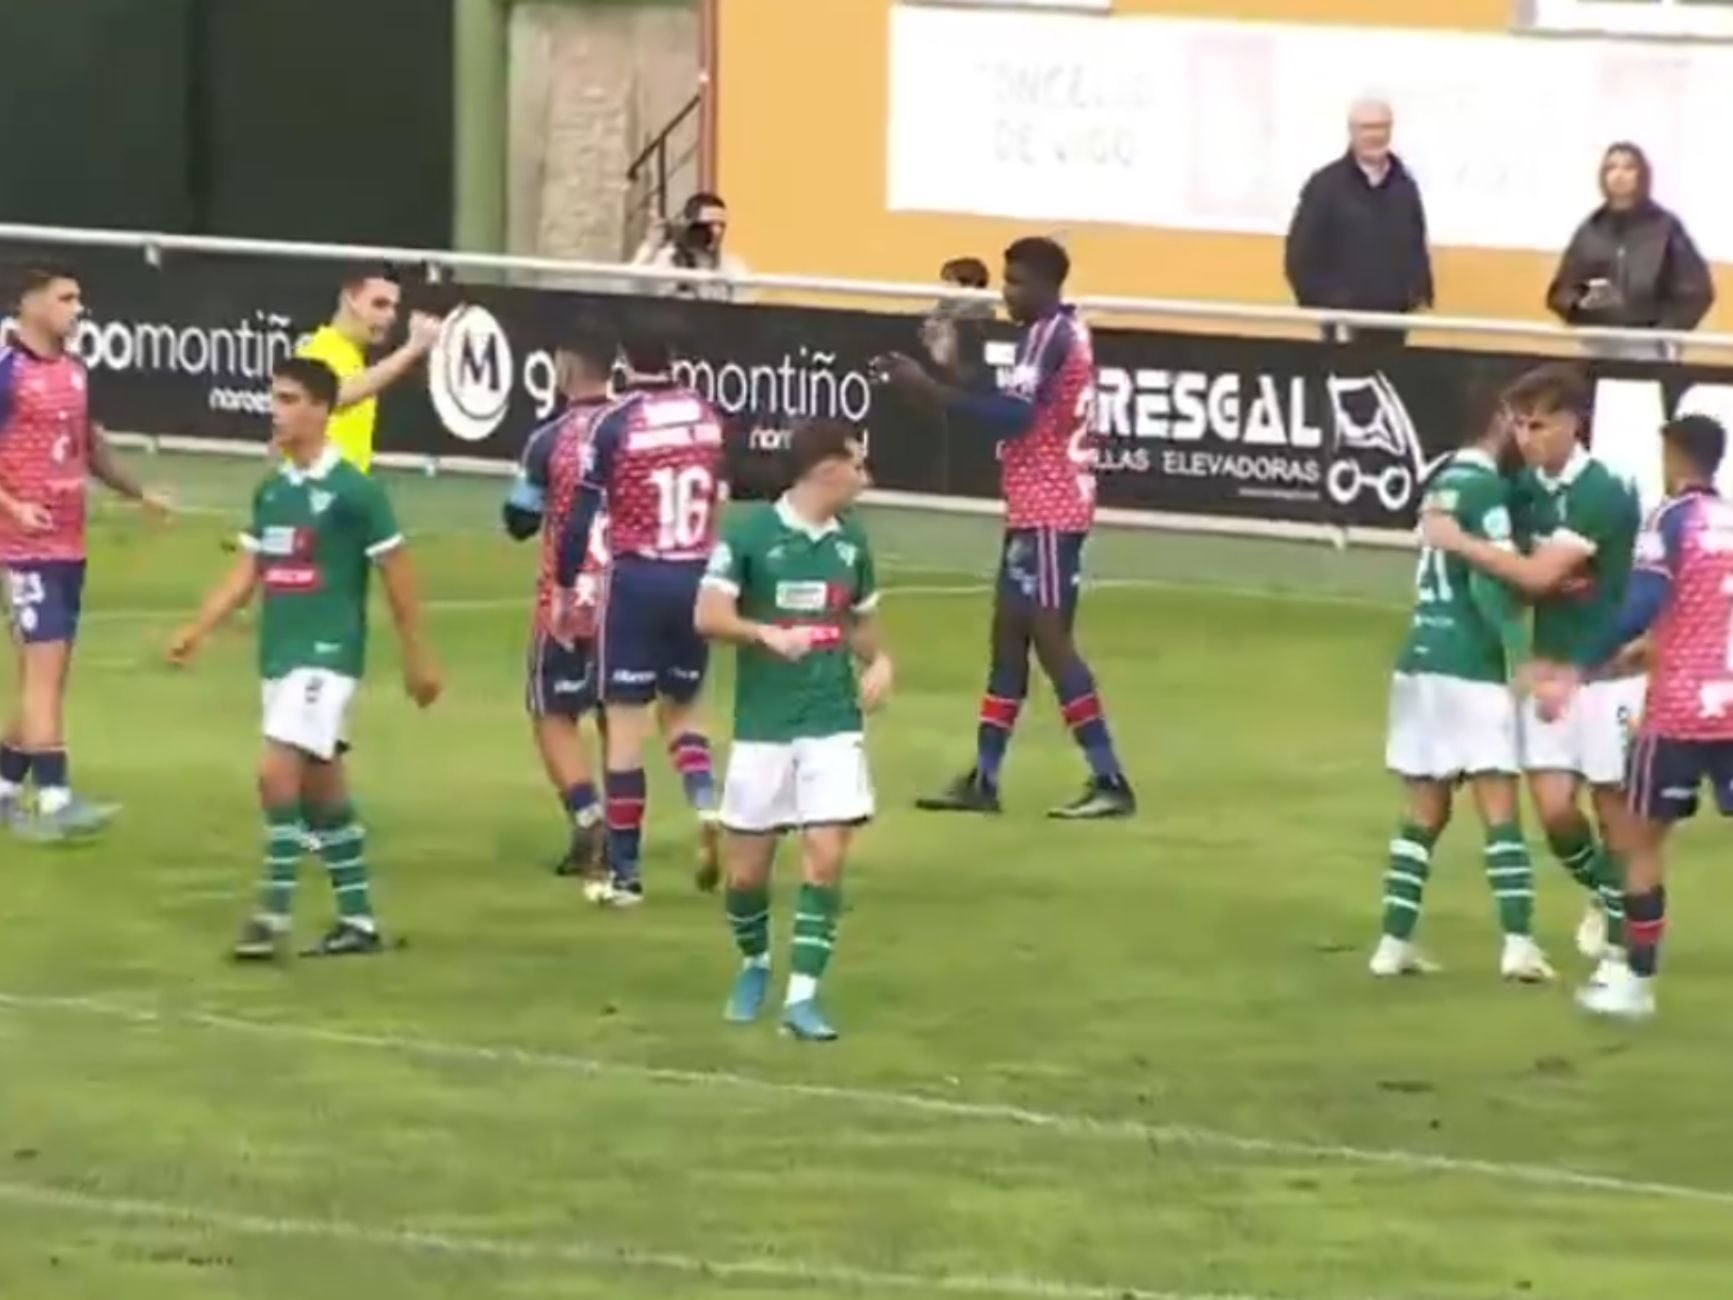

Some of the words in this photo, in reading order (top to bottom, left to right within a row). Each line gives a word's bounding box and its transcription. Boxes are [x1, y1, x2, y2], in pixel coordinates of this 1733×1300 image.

[459, 330, 499, 391] M
[1163, 451, 1320, 483] ELEVADORAS
[648, 467, 712, 549] 16
